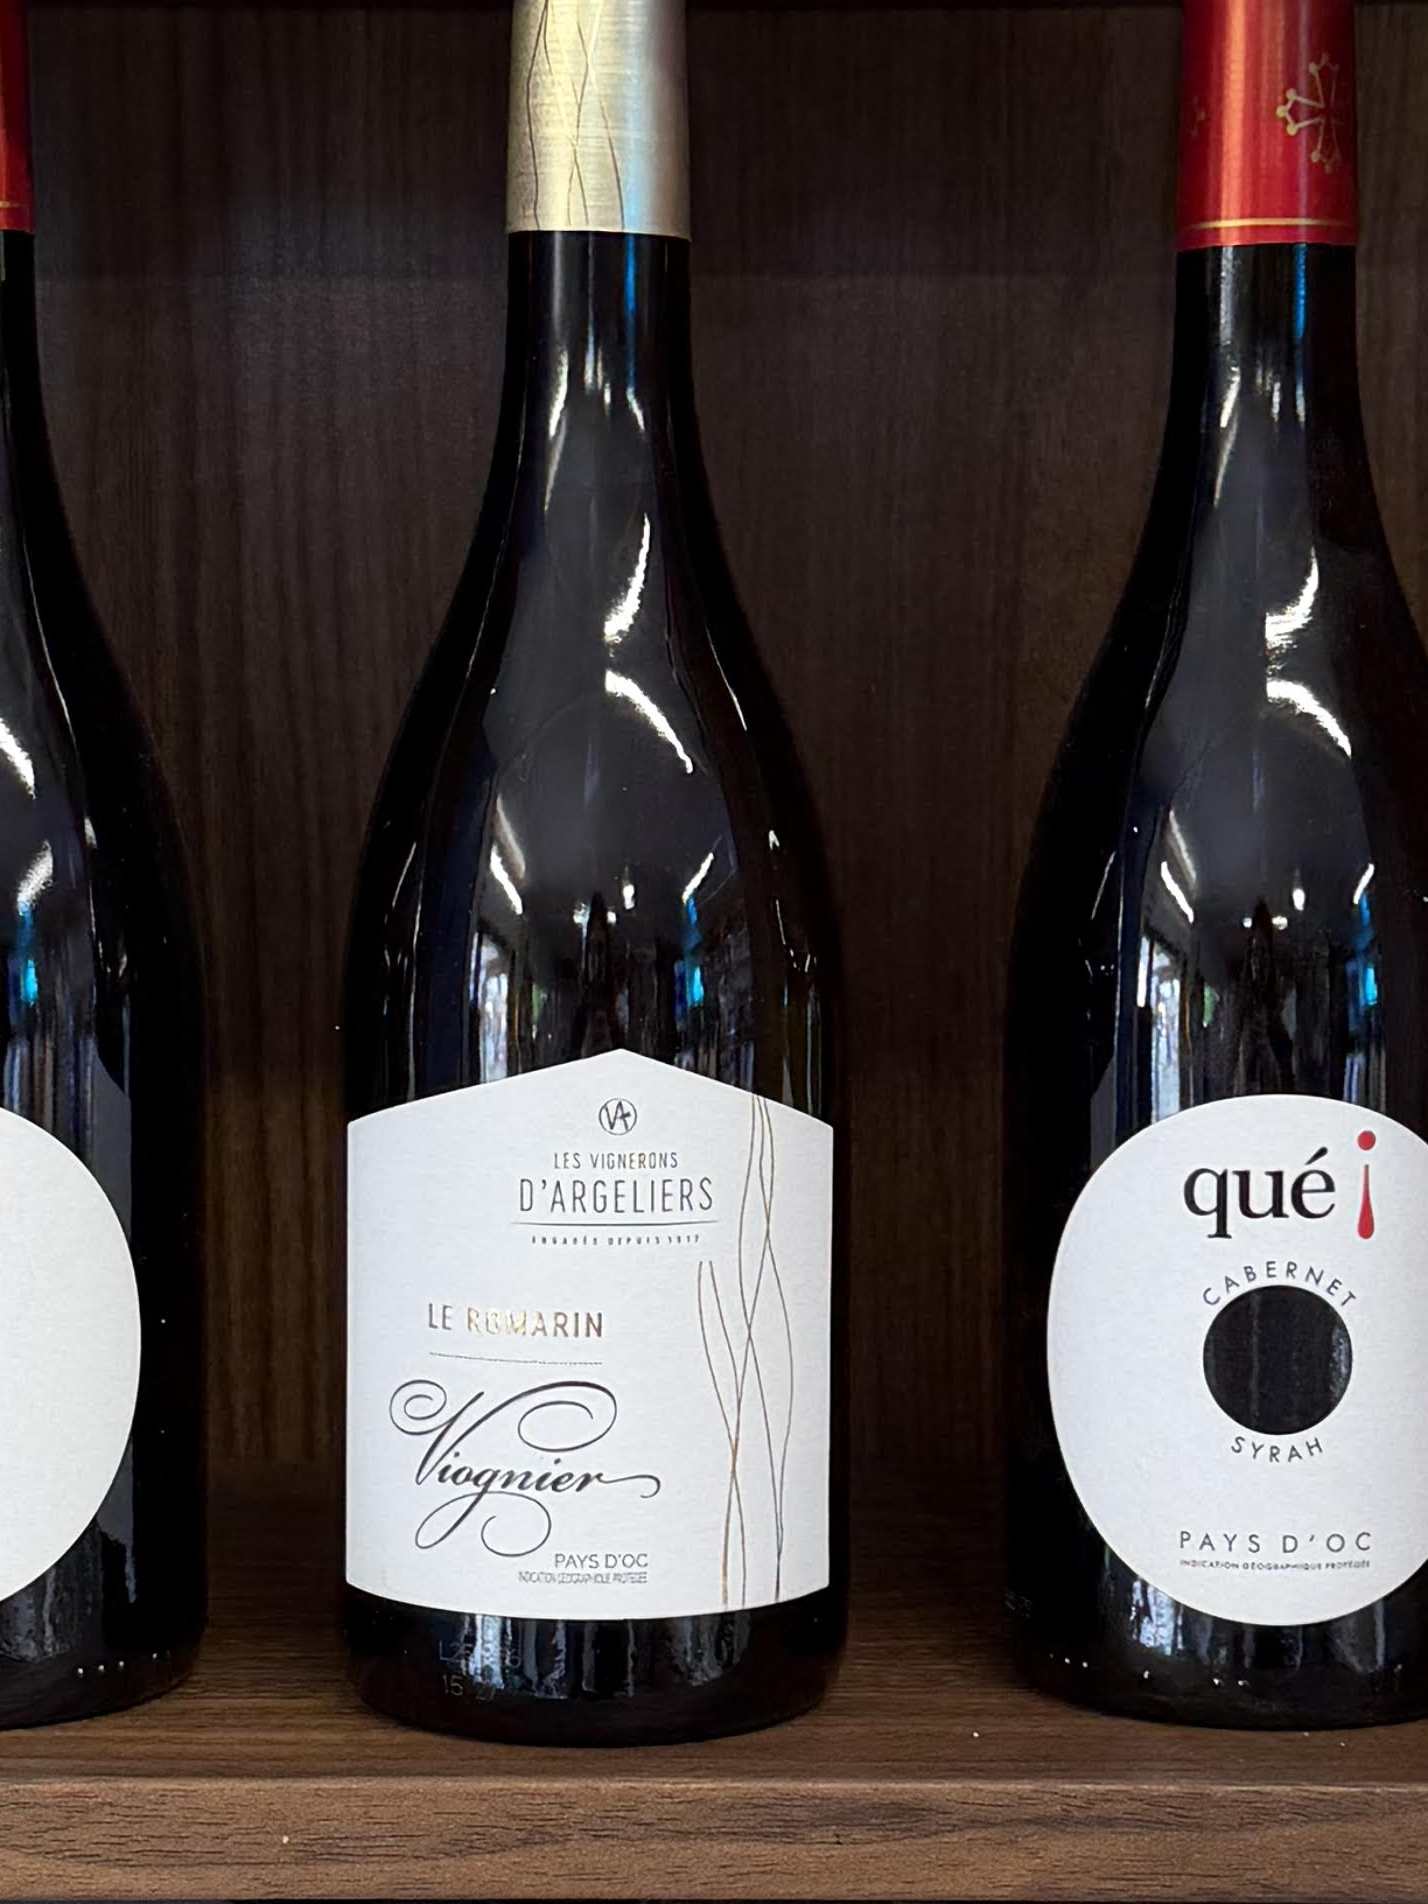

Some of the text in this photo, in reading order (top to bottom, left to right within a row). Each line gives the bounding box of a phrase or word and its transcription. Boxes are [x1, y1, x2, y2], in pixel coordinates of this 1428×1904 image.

[554, 1152, 678, 1169] LES VIGNERONS
[520, 1177, 713, 1213] D'ARGELIERS
[1204, 1260, 1356, 1307] CABERNET
[428, 1303, 603, 1338] LE ROMARIN
[1231, 1435, 1323, 1463] SYRAH
[389, 1379, 660, 1557] Viognier
[1180, 1531, 1371, 1553] PAYS D'OC
[555, 1553, 648, 1568] PAYS D'OC
